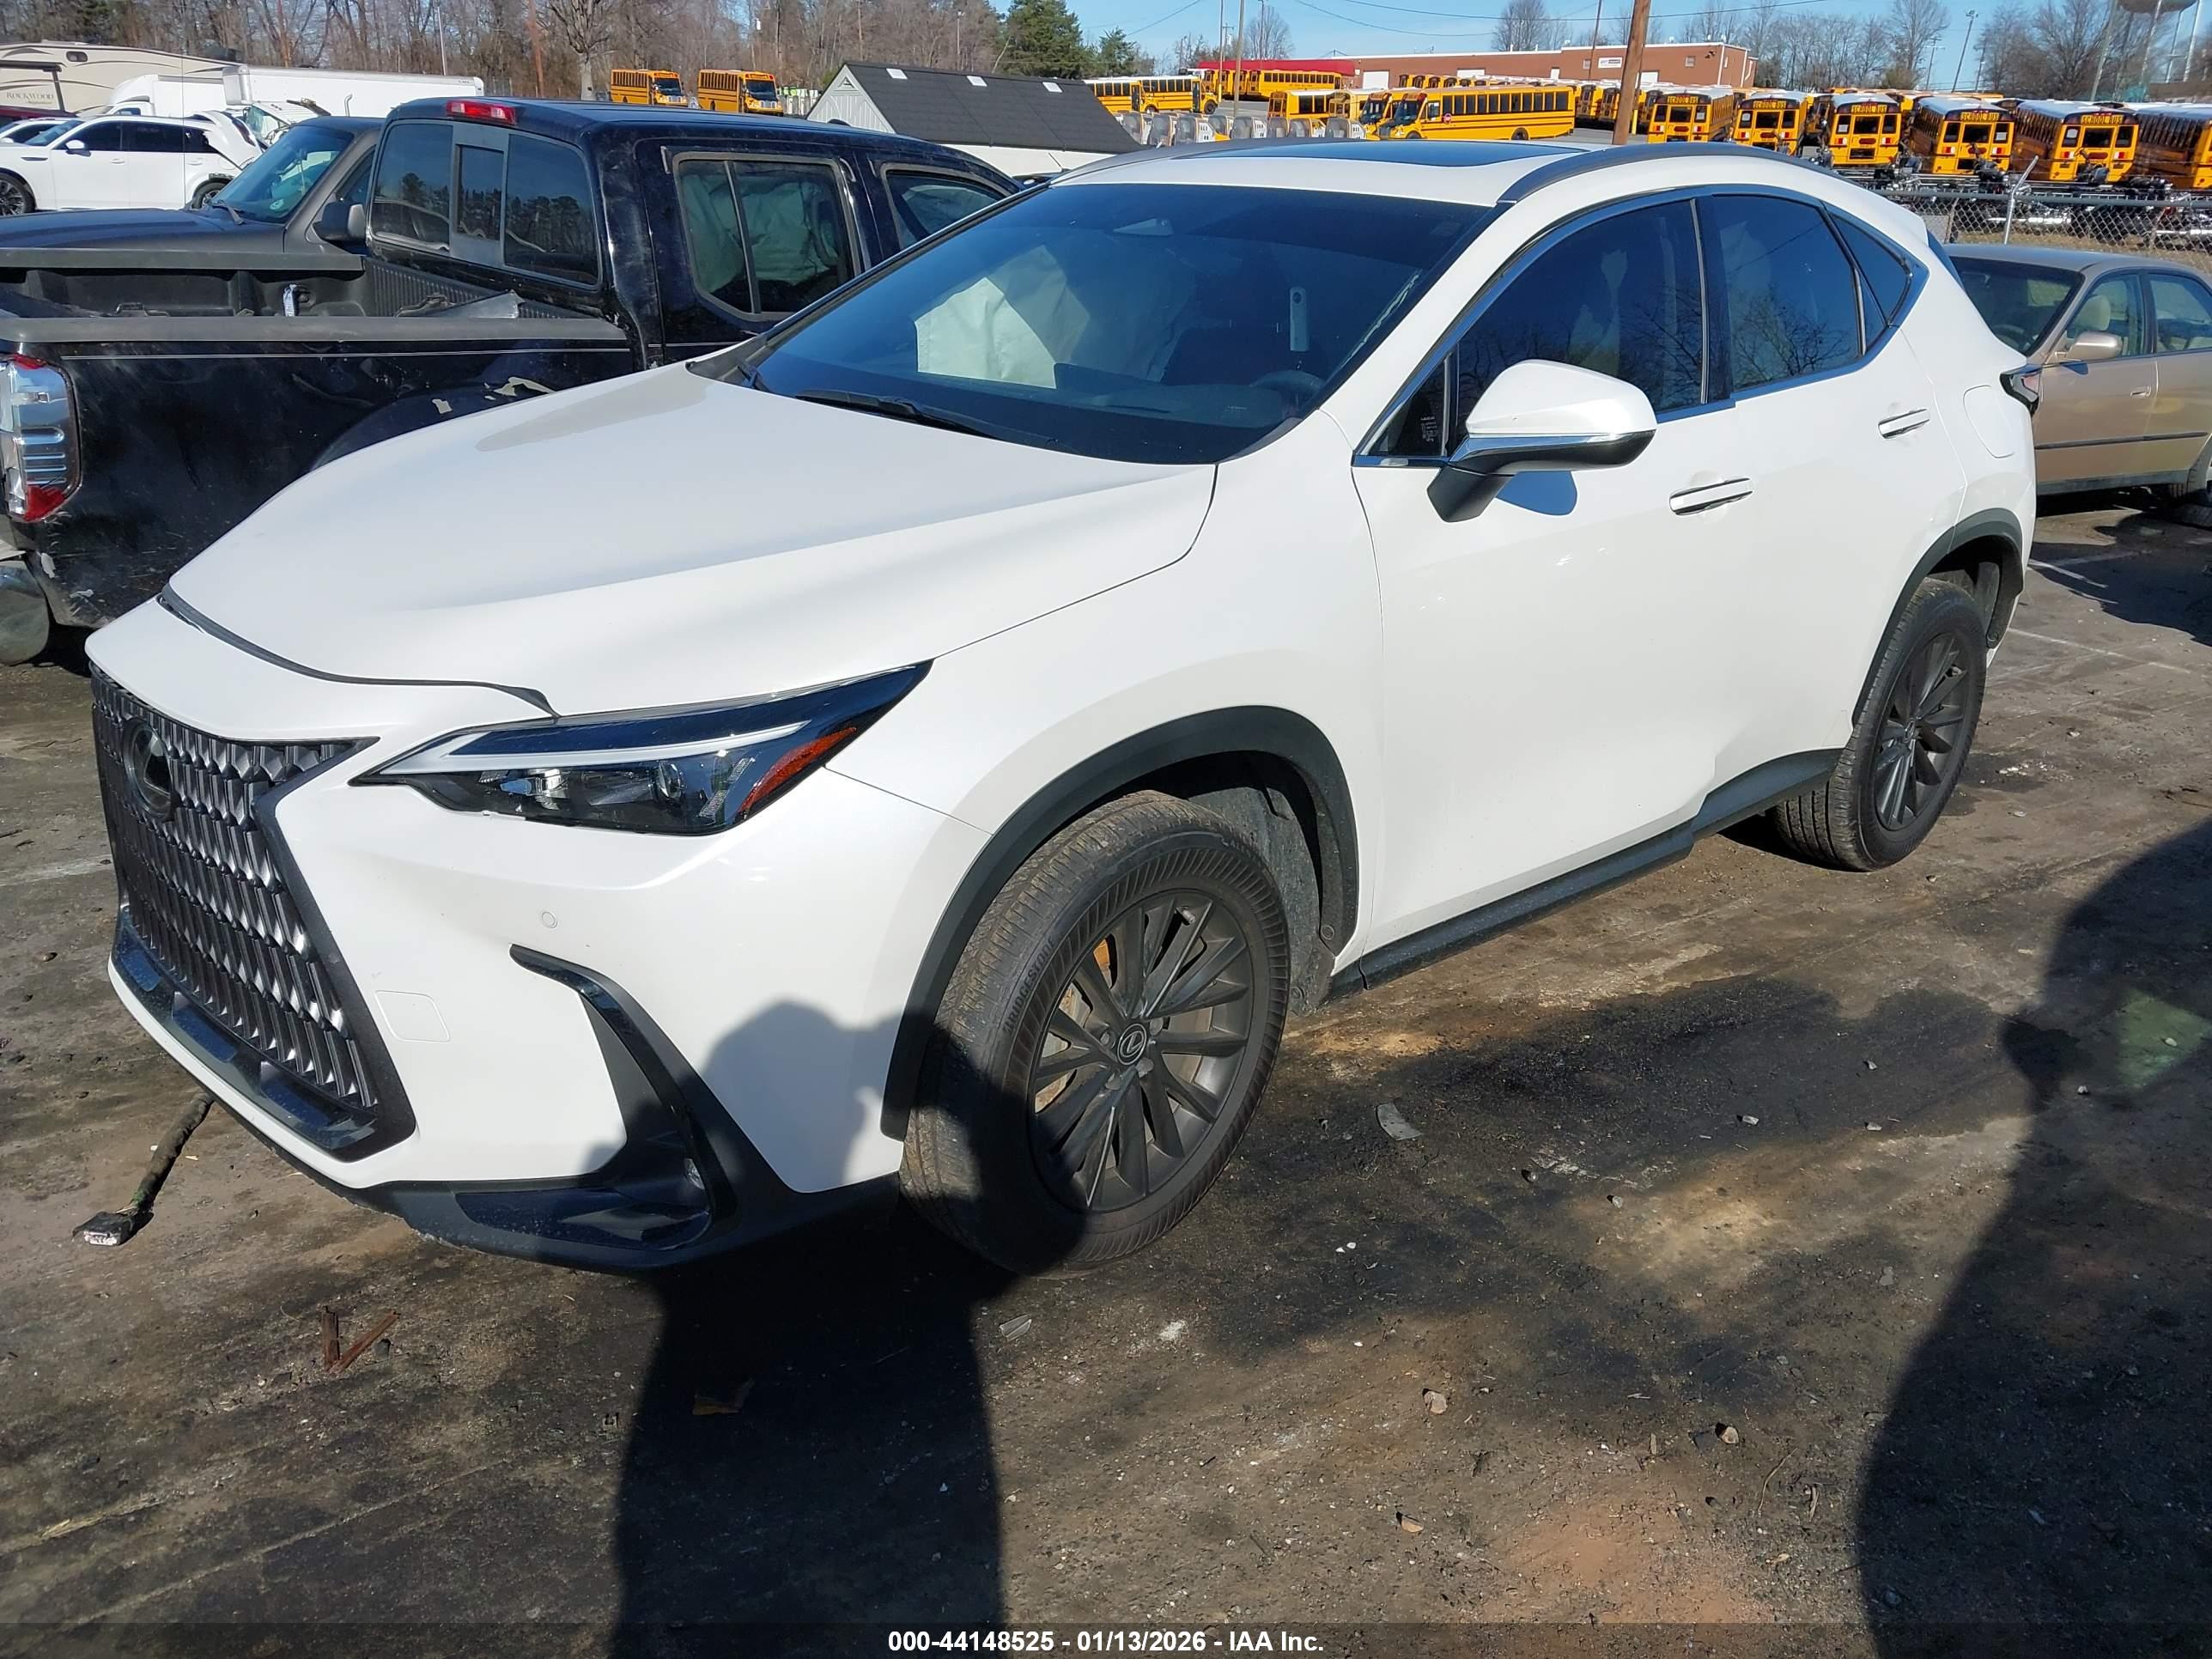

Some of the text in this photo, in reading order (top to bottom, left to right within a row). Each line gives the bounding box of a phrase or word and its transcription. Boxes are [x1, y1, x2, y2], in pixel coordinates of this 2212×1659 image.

[1852, 104, 1873, 113] SCHOOL
[1962, 112, 1999, 121] SCHOOL BUS
[2082, 115, 2122, 125] SCHOOL BUS
[1003, 935, 1054, 1032] BRIDGESTONE
